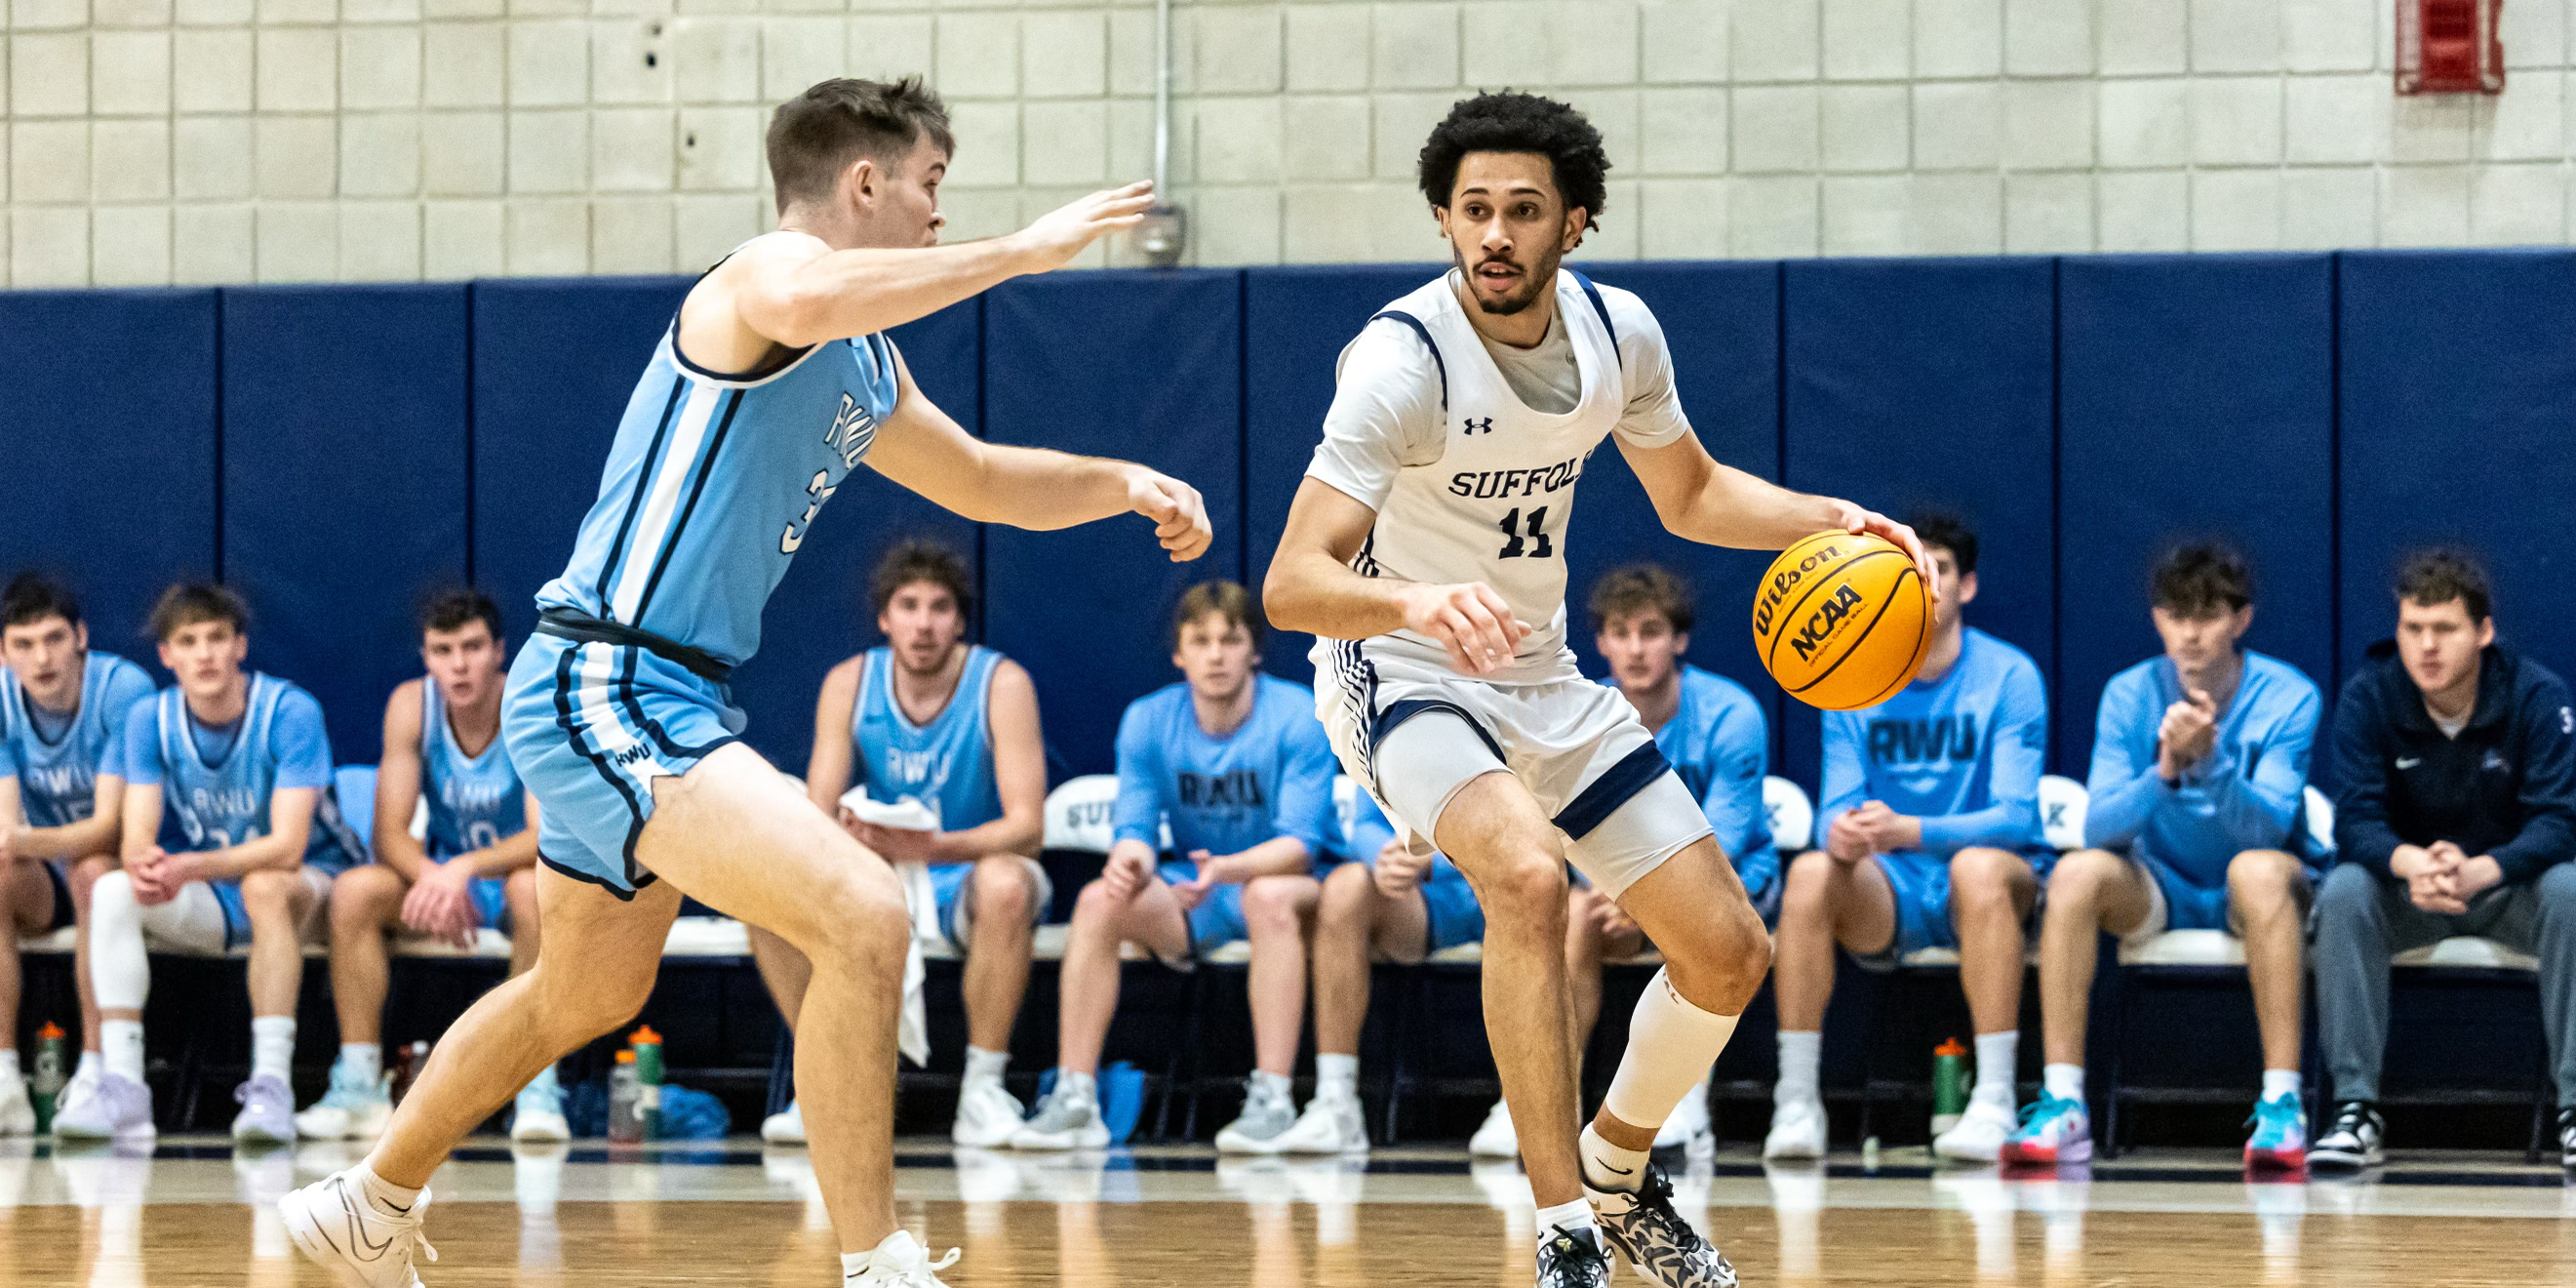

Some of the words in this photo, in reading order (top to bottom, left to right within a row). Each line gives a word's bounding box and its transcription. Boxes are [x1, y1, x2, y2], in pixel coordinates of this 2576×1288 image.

[1498, 504, 1553, 560] 11
[1755, 544, 1844, 637] Wilson
[1790, 583, 1864, 663] NCAA
[1868, 714, 1976, 763] RWU
[193, 786, 256, 819] RWU
